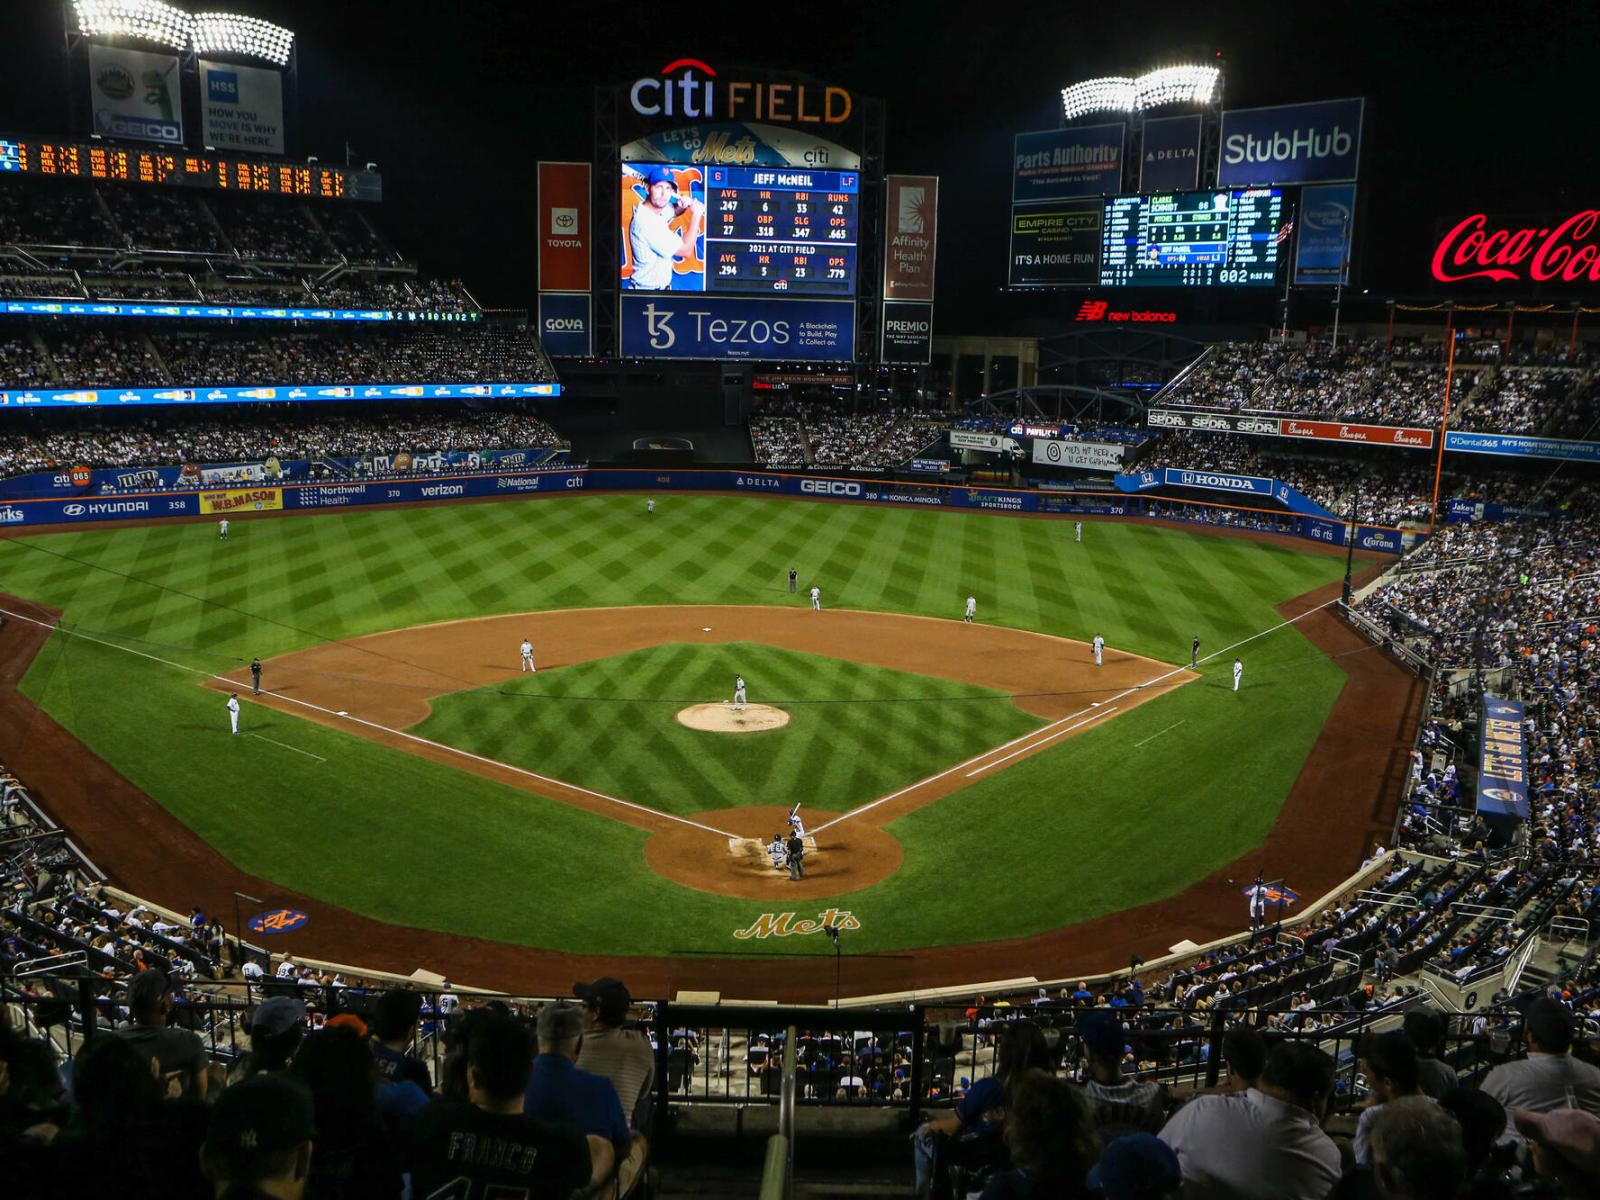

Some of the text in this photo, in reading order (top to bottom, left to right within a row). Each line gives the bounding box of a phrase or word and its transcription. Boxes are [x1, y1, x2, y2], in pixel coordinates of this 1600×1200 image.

[211, 81, 235, 93] HSS
[728, 82, 852, 122] FIELD
[209, 107, 257, 121] HOW YOU
[112, 120, 178, 139] GEICO
[209, 119, 276, 135] MOVE IS WHY
[663, 128, 699, 142] LET'S
[683, 139, 700, 150] GO
[692, 131, 755, 164] Mets
[1225, 126, 1352, 164] StubHub
[1016, 144, 1118, 169] Parts Authority
[1158, 149, 1194, 160] DELTA
[714, 172, 722, 181] 6
[754, 174, 813, 186] JEFF McNEIL
[842, 178, 854, 186] LF
[721, 190, 736, 198] AVG
[796, 192, 808, 200] RBI
[828, 194, 848, 202] RUNS
[720, 201, 737, 210] .247
[762, 202, 768, 212] 6
[832, 205, 844, 214] 42
[724, 214, 846, 226] BB OBP SLG OPS
[1018, 216, 1095, 229] EMPIRE CITY
[724, 226, 846, 239] 27 .318 .347 .665
[548, 240, 582, 248] TOYOTA
[892, 236, 929, 249] Affinity
[750, 244, 766, 252] 2021
[780, 246, 794, 254] CITI
[796, 246, 815, 254] FIELD
[894, 250, 927, 260] Health
[720, 254, 736, 262] AVG
[759, 256, 770, 264] HR
[829, 258, 844, 266] OPS
[1016, 254, 1094, 265] IT'S A HOME RUN
[719, 266, 845, 278] .294 5 23 .779
[900, 262, 920, 272] Plan
[1108, 310, 1176, 322] new balance
[546, 319, 584, 330] GOYA
[688, 311, 790, 344] Tezos
[887, 321, 928, 332] PREMIO
[1457, 436, 1498, 448] Dental365
[1518, 441, 1560, 449] HOMETOWN
[1076, 456, 1087, 464] GET
[54, 472, 88, 484] citi 065
[507, 477, 538, 486] National
[566, 476, 583, 488] citi
[748, 478, 780, 487] DELTA
[1196, 475, 1254, 490] HONDA
[320, 486, 366, 495] Northwell
[422, 485, 463, 496] verizon
[800, 480, 860, 495] GEICO
[168, 502, 186, 510] 358
[320, 496, 349, 504] Health
[914, 496, 942, 504] MINOLTA
[89, 502, 148, 514] HYUNDAI
[1452, 502, 1474, 512] Jake's
[1363, 536, 1394, 548] Corona
[733, 908, 860, 939] Mets
